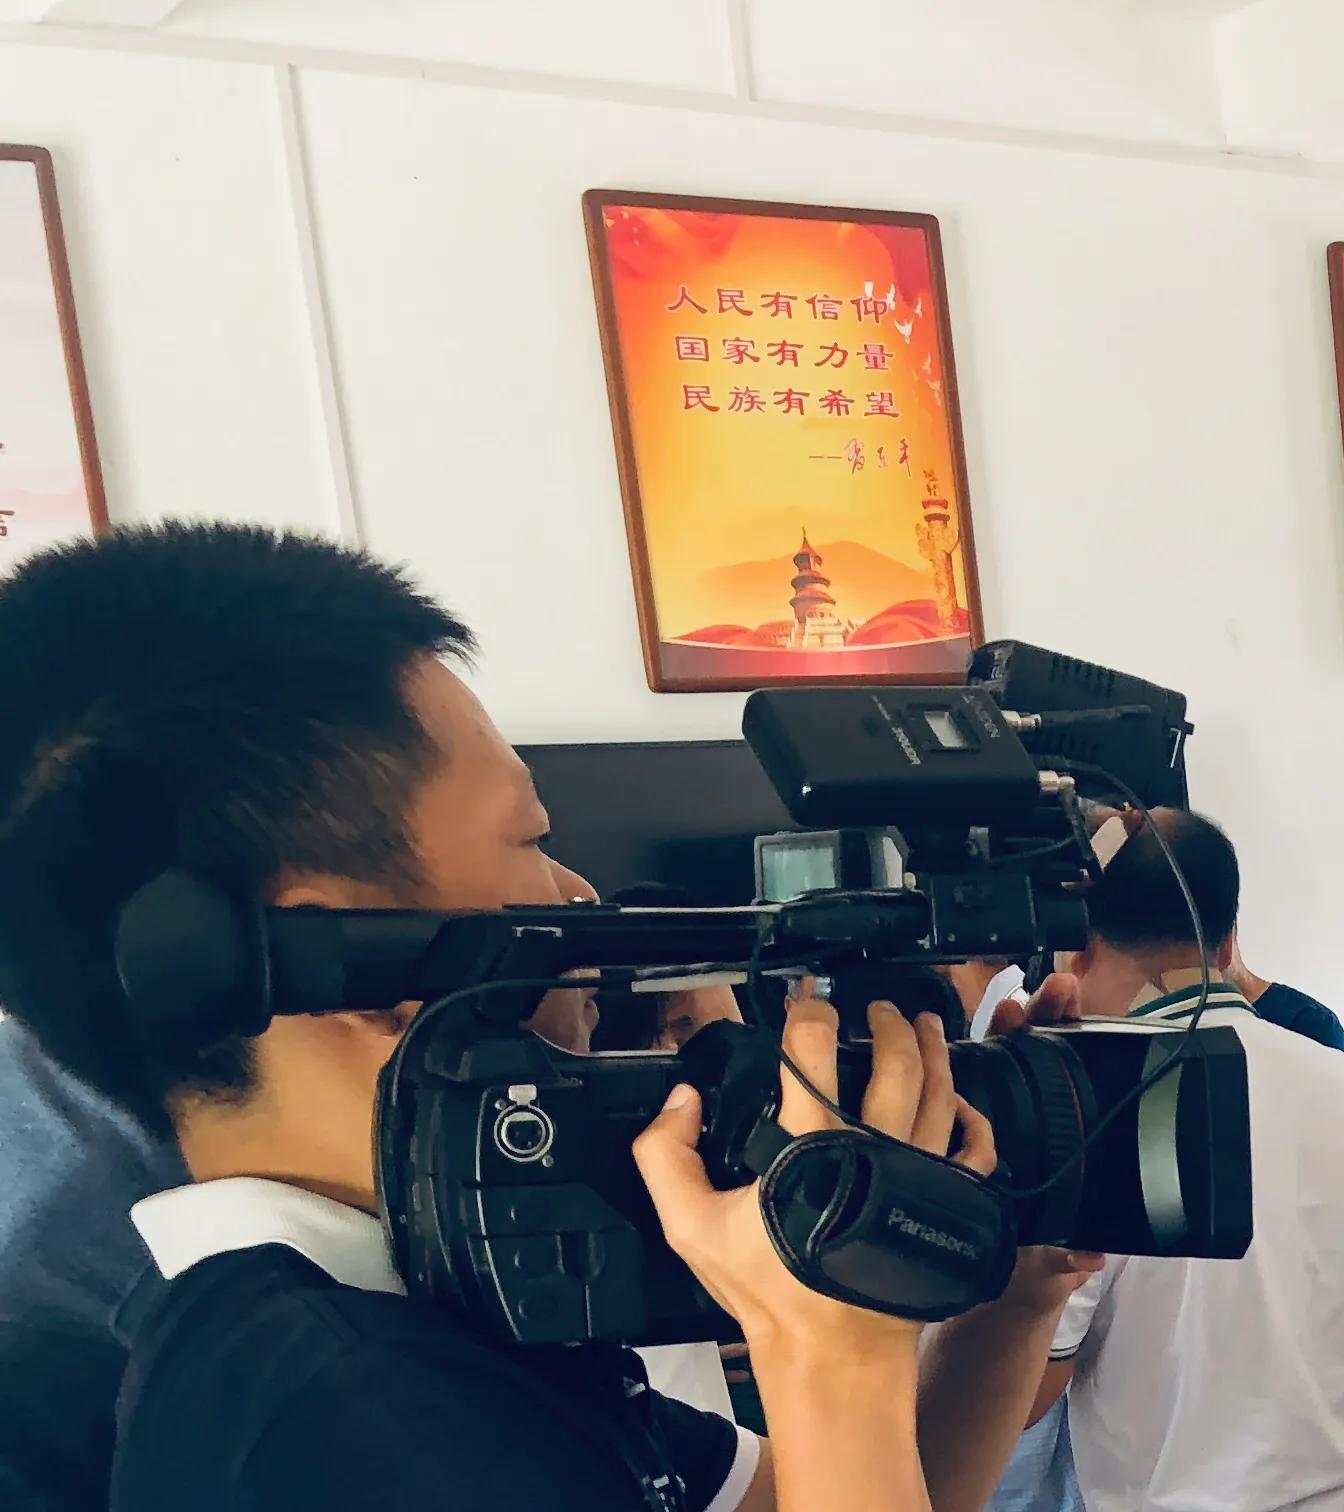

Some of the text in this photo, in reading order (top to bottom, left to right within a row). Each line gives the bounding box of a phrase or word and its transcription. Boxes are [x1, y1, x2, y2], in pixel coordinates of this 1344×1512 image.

[667, 286, 889, 324] 人民有信仰
[675, 335, 894, 372] 国家有力量
[682, 384, 901, 420] 民族有希望
